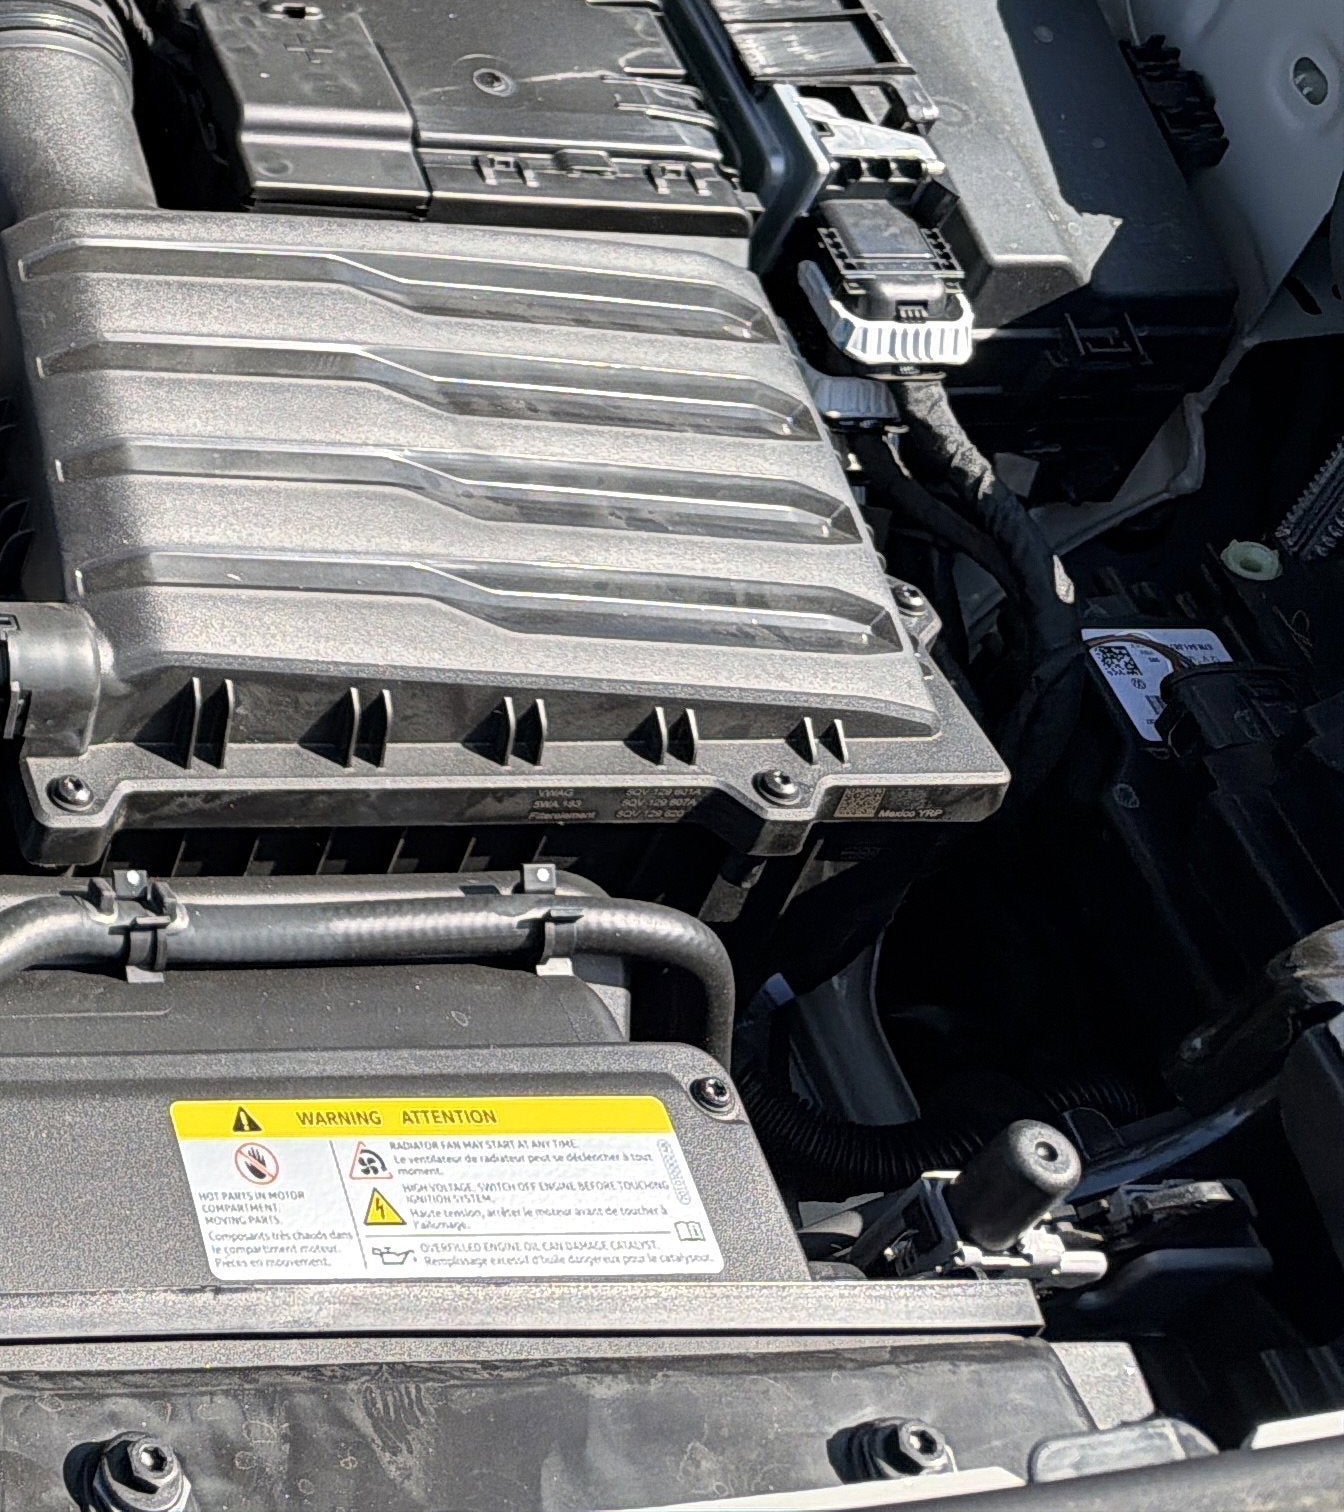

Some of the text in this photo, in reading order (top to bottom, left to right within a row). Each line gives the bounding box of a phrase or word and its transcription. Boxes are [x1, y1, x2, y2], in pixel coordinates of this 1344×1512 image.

[878, 807, 915, 819] Mexico
[295, 1110, 383, 1126] WARNING
[401, 1109, 498, 1125] ATTENTION
[389, 1141, 438, 1150] RADIATOR
[440, 1141, 461, 1150] FAN
[198, 1191, 220, 1201] HOT
[268, 1191, 305, 1200] MOTOR
